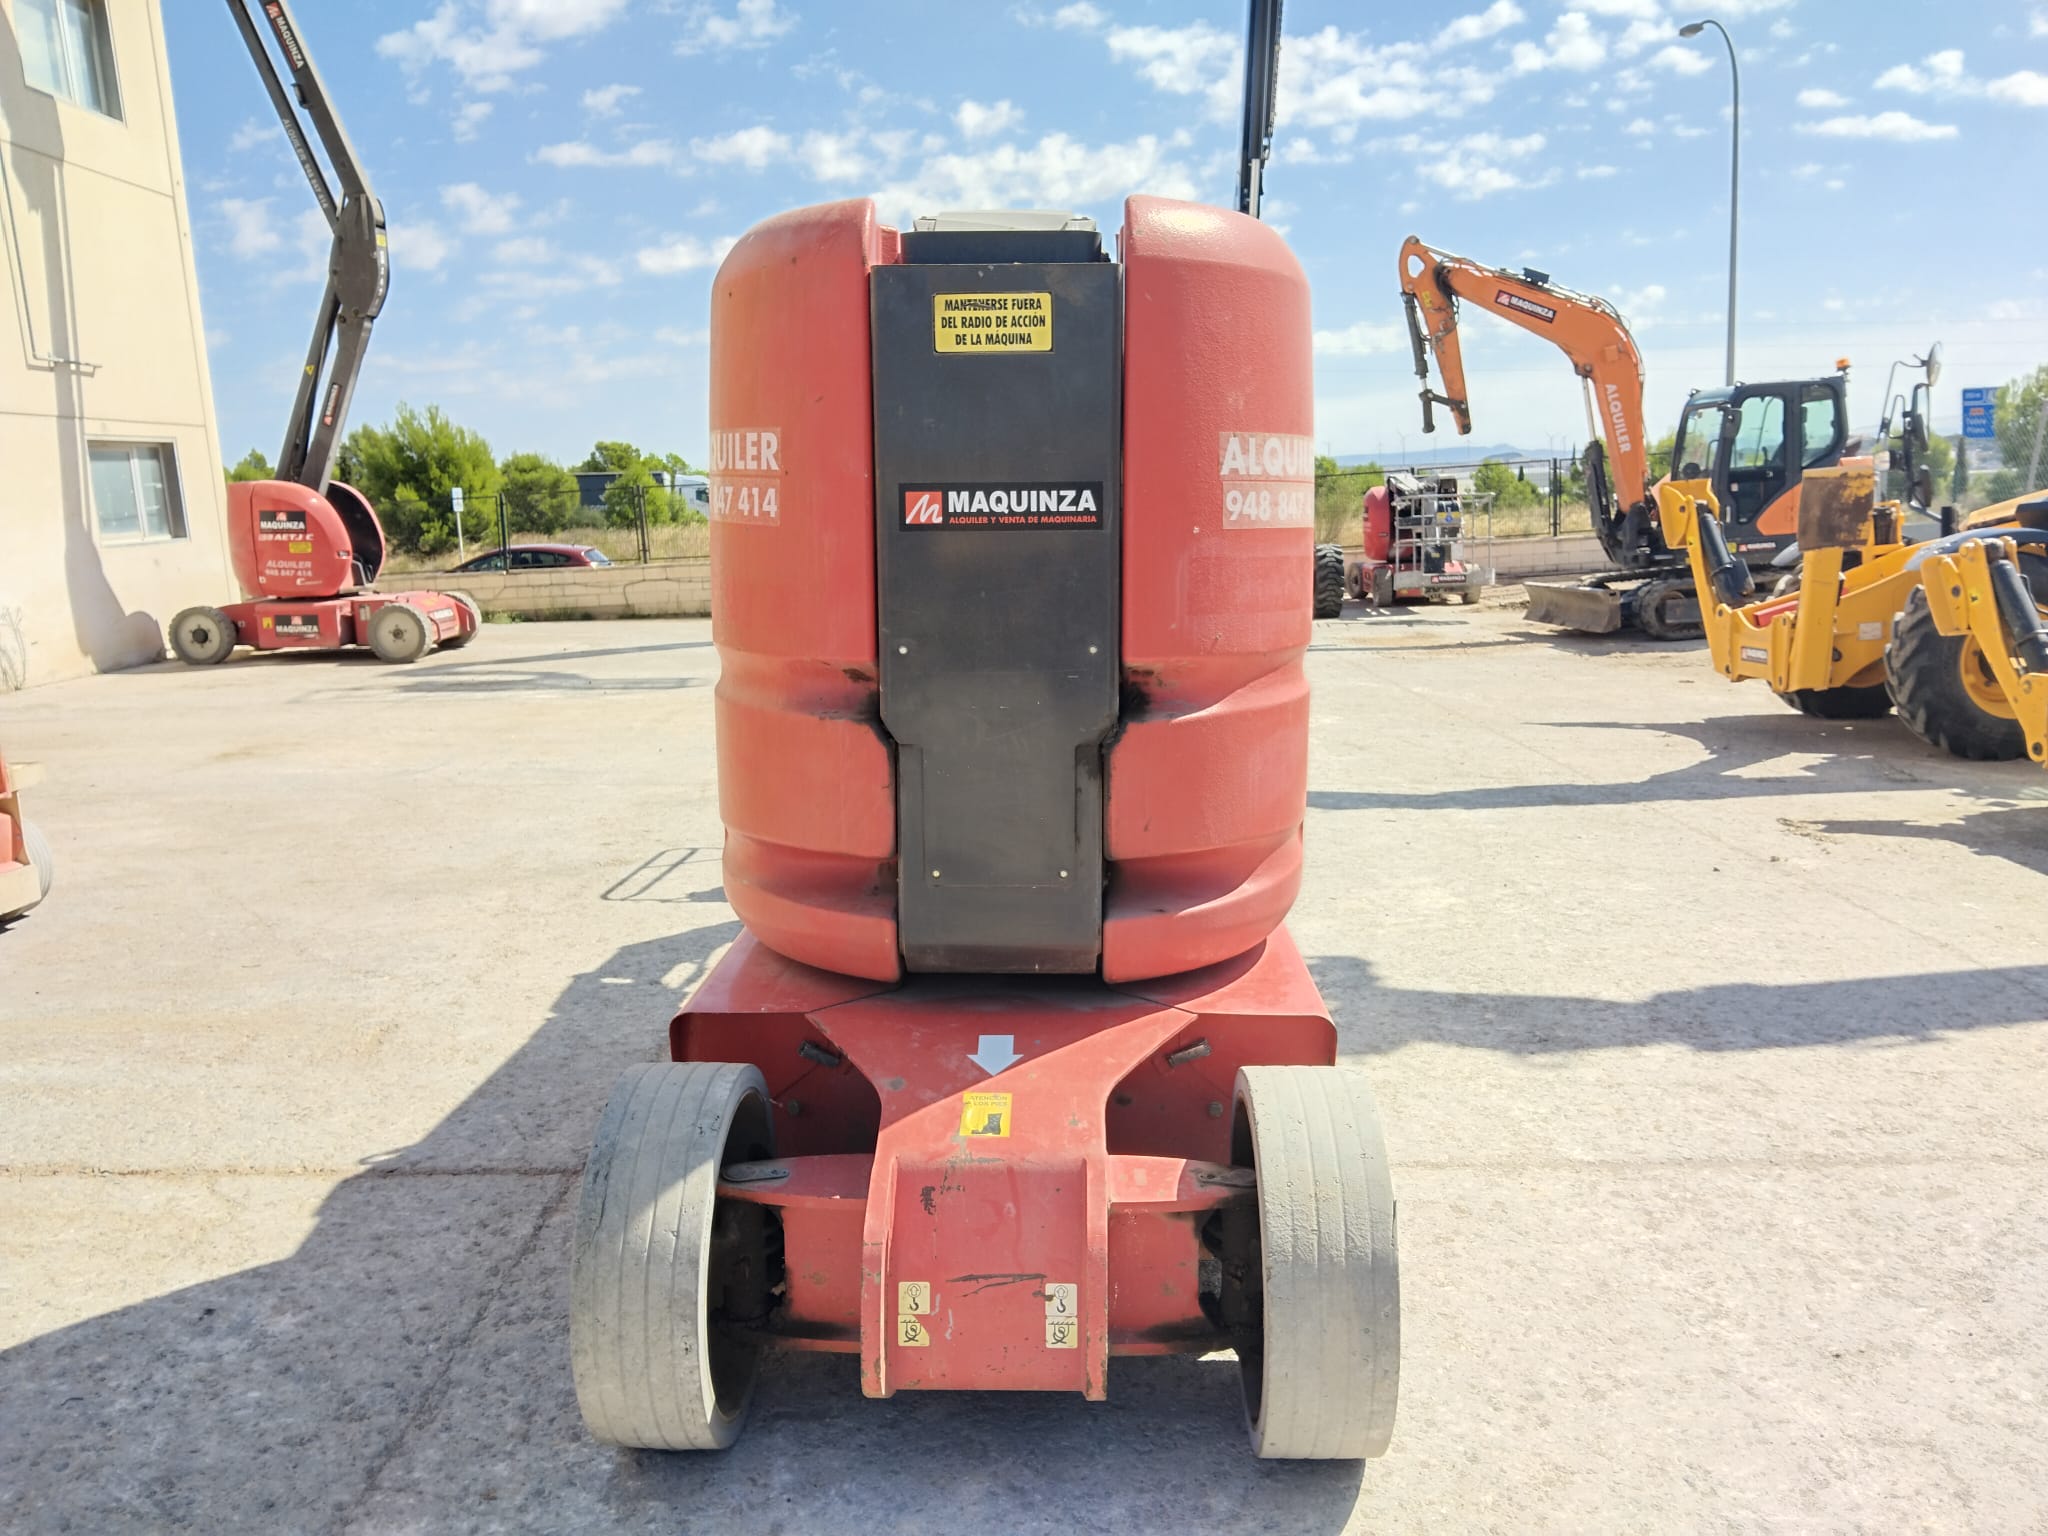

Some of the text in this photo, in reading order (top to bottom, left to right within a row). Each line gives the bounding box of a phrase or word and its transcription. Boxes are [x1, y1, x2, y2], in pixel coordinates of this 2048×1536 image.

[275, 16, 304, 69] MAQUINZA
[945, 298, 1042, 311] MANTENERSE FUERA
[1510, 296, 1554, 319] MAQUINZA
[941, 312, 1045, 328] DEL RADIO DE ACCIÓN
[956, 334, 967, 345] DE
[971, 334, 982, 345] LA
[1606, 384, 1632, 453] ALQUILER
[738, 487, 778, 518] 414
[948, 490, 1097, 514] MAQUINZA
[1226, 490, 1271, 521] 948
[260, 521, 306, 530] MAQUINZA
[999, 516, 1025, 524] VENTA
[1028, 516, 1038, 524] DE
[1041, 515, 1096, 524] MAQUINARIA
[266, 560, 312, 568] ALQUILER
